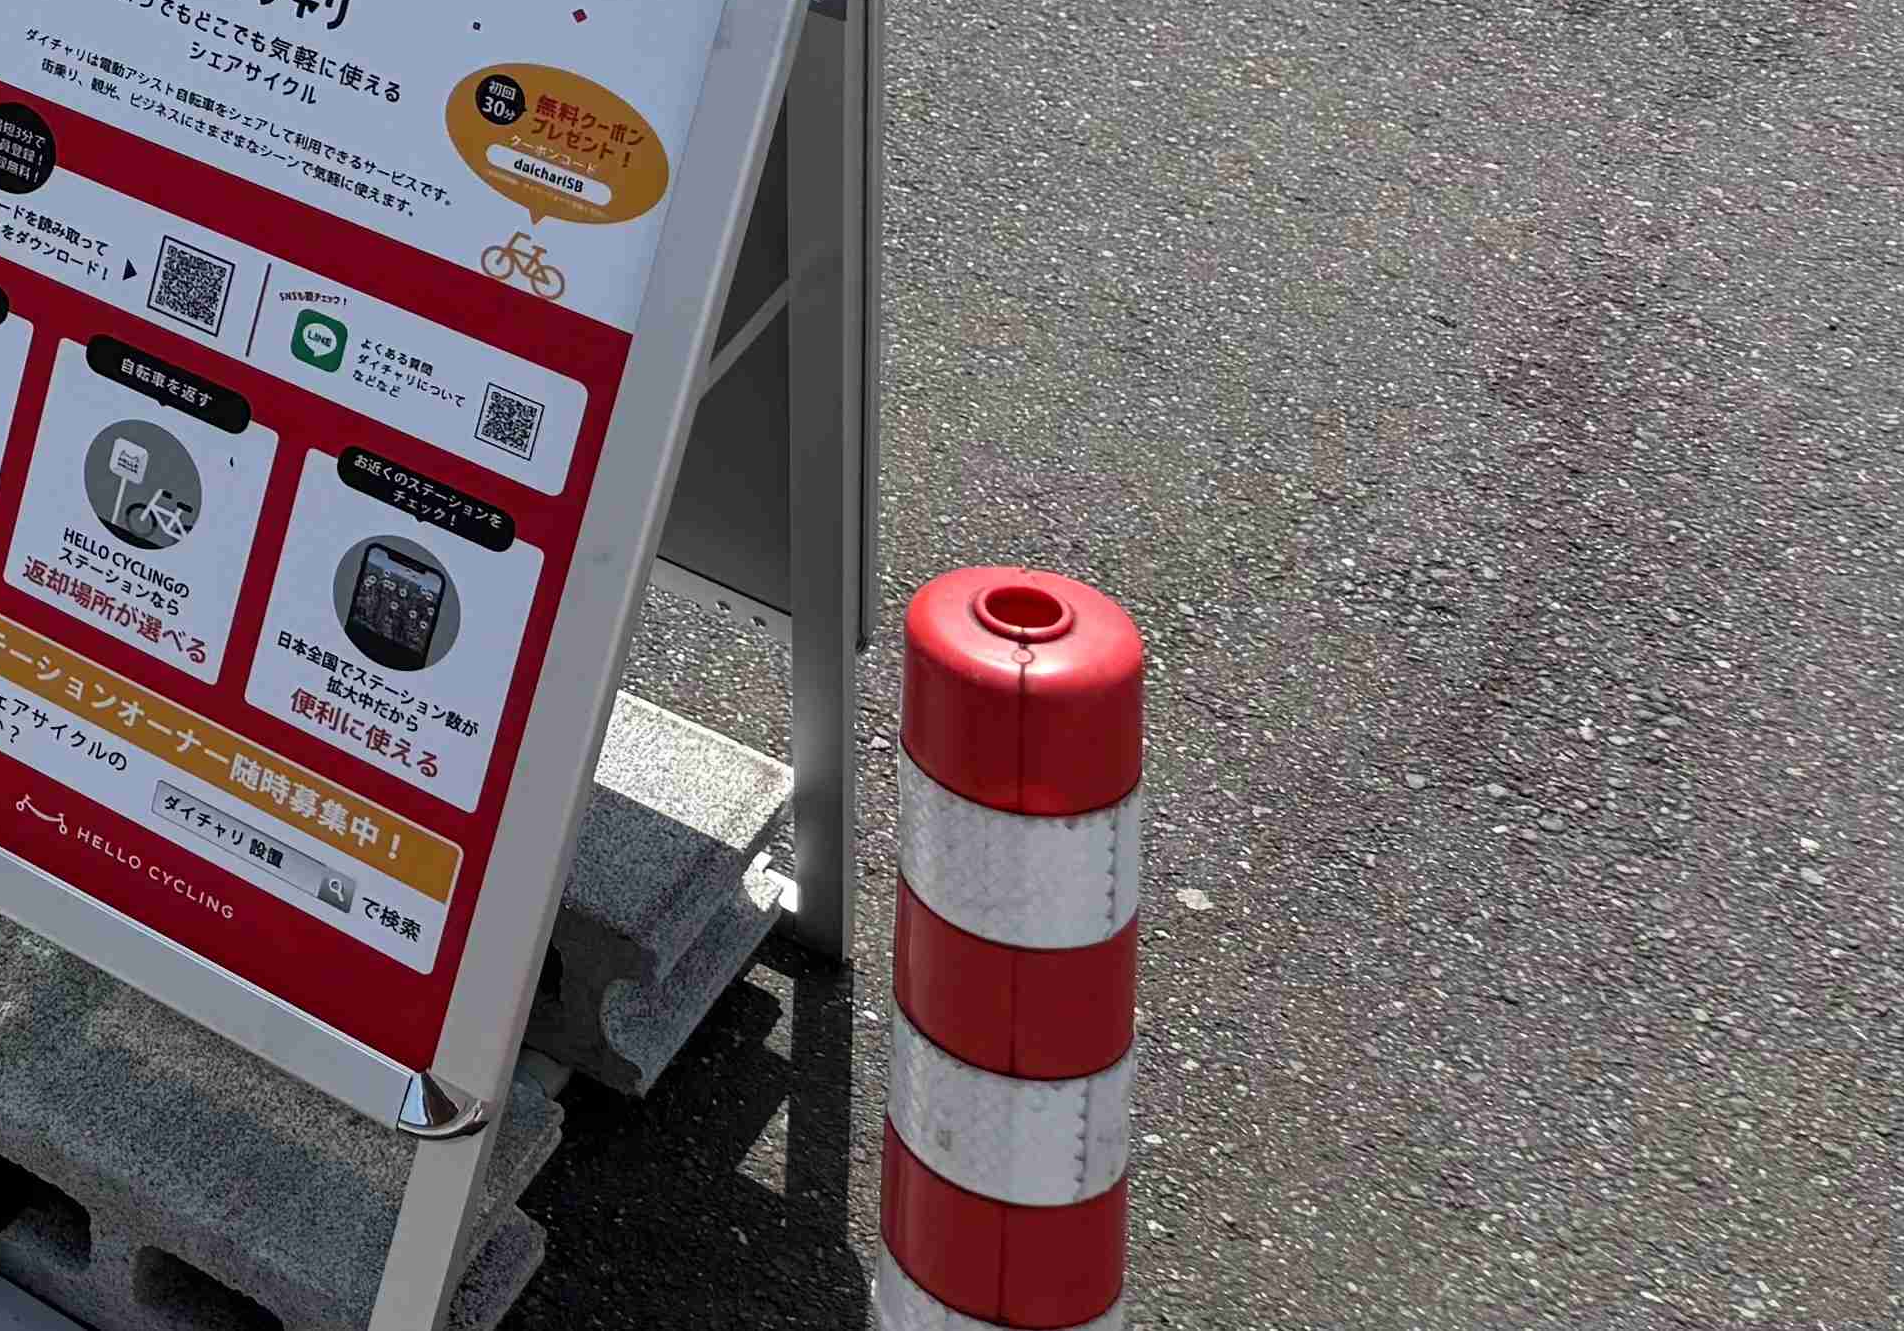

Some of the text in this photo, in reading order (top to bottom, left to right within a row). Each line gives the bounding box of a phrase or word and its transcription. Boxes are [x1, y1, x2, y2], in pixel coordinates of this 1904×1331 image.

[188, 40, 318, 107] シェアサイクル
[488, 81, 516, 101] 初回
[25, 28, 454, 208] ダイチャリは電動アシスト自転車をシェアして利用できるサービスです。
[41, 56, 416, 218] 街乗り、観光、ビジネスにさまざまなシーンで気軽に使えます。
[482, 96, 516, 121] 30分
[534, 94, 644, 147] 無料クーポン
[120, 358, 213, 408] 自転車を返す
[353, 369, 400, 399] などなど
[356, 353, 466, 409] ダイチャリについて
[360, 339, 433, 377] よくある質問
[353, 454, 503, 529] お近くのステーションを
[392, 489, 458, 527] チェック！
[58, 548, 180, 617] ステーションなら
[63, 527, 189, 599] HELLO CYCLINGの
[22, 556, 206, 665] 返却場所が選べる
[277, 631, 479, 738] 日本全国でステーション数が
[327, 676, 419, 733] 拡大中だから
[291, 687, 438, 779] 便利に使える
[163, 794, 284, 870] ダイチャリ 設置
[77, 827, 235, 920] HELLO CYCLING
[360, 897, 422, 943] で検索
